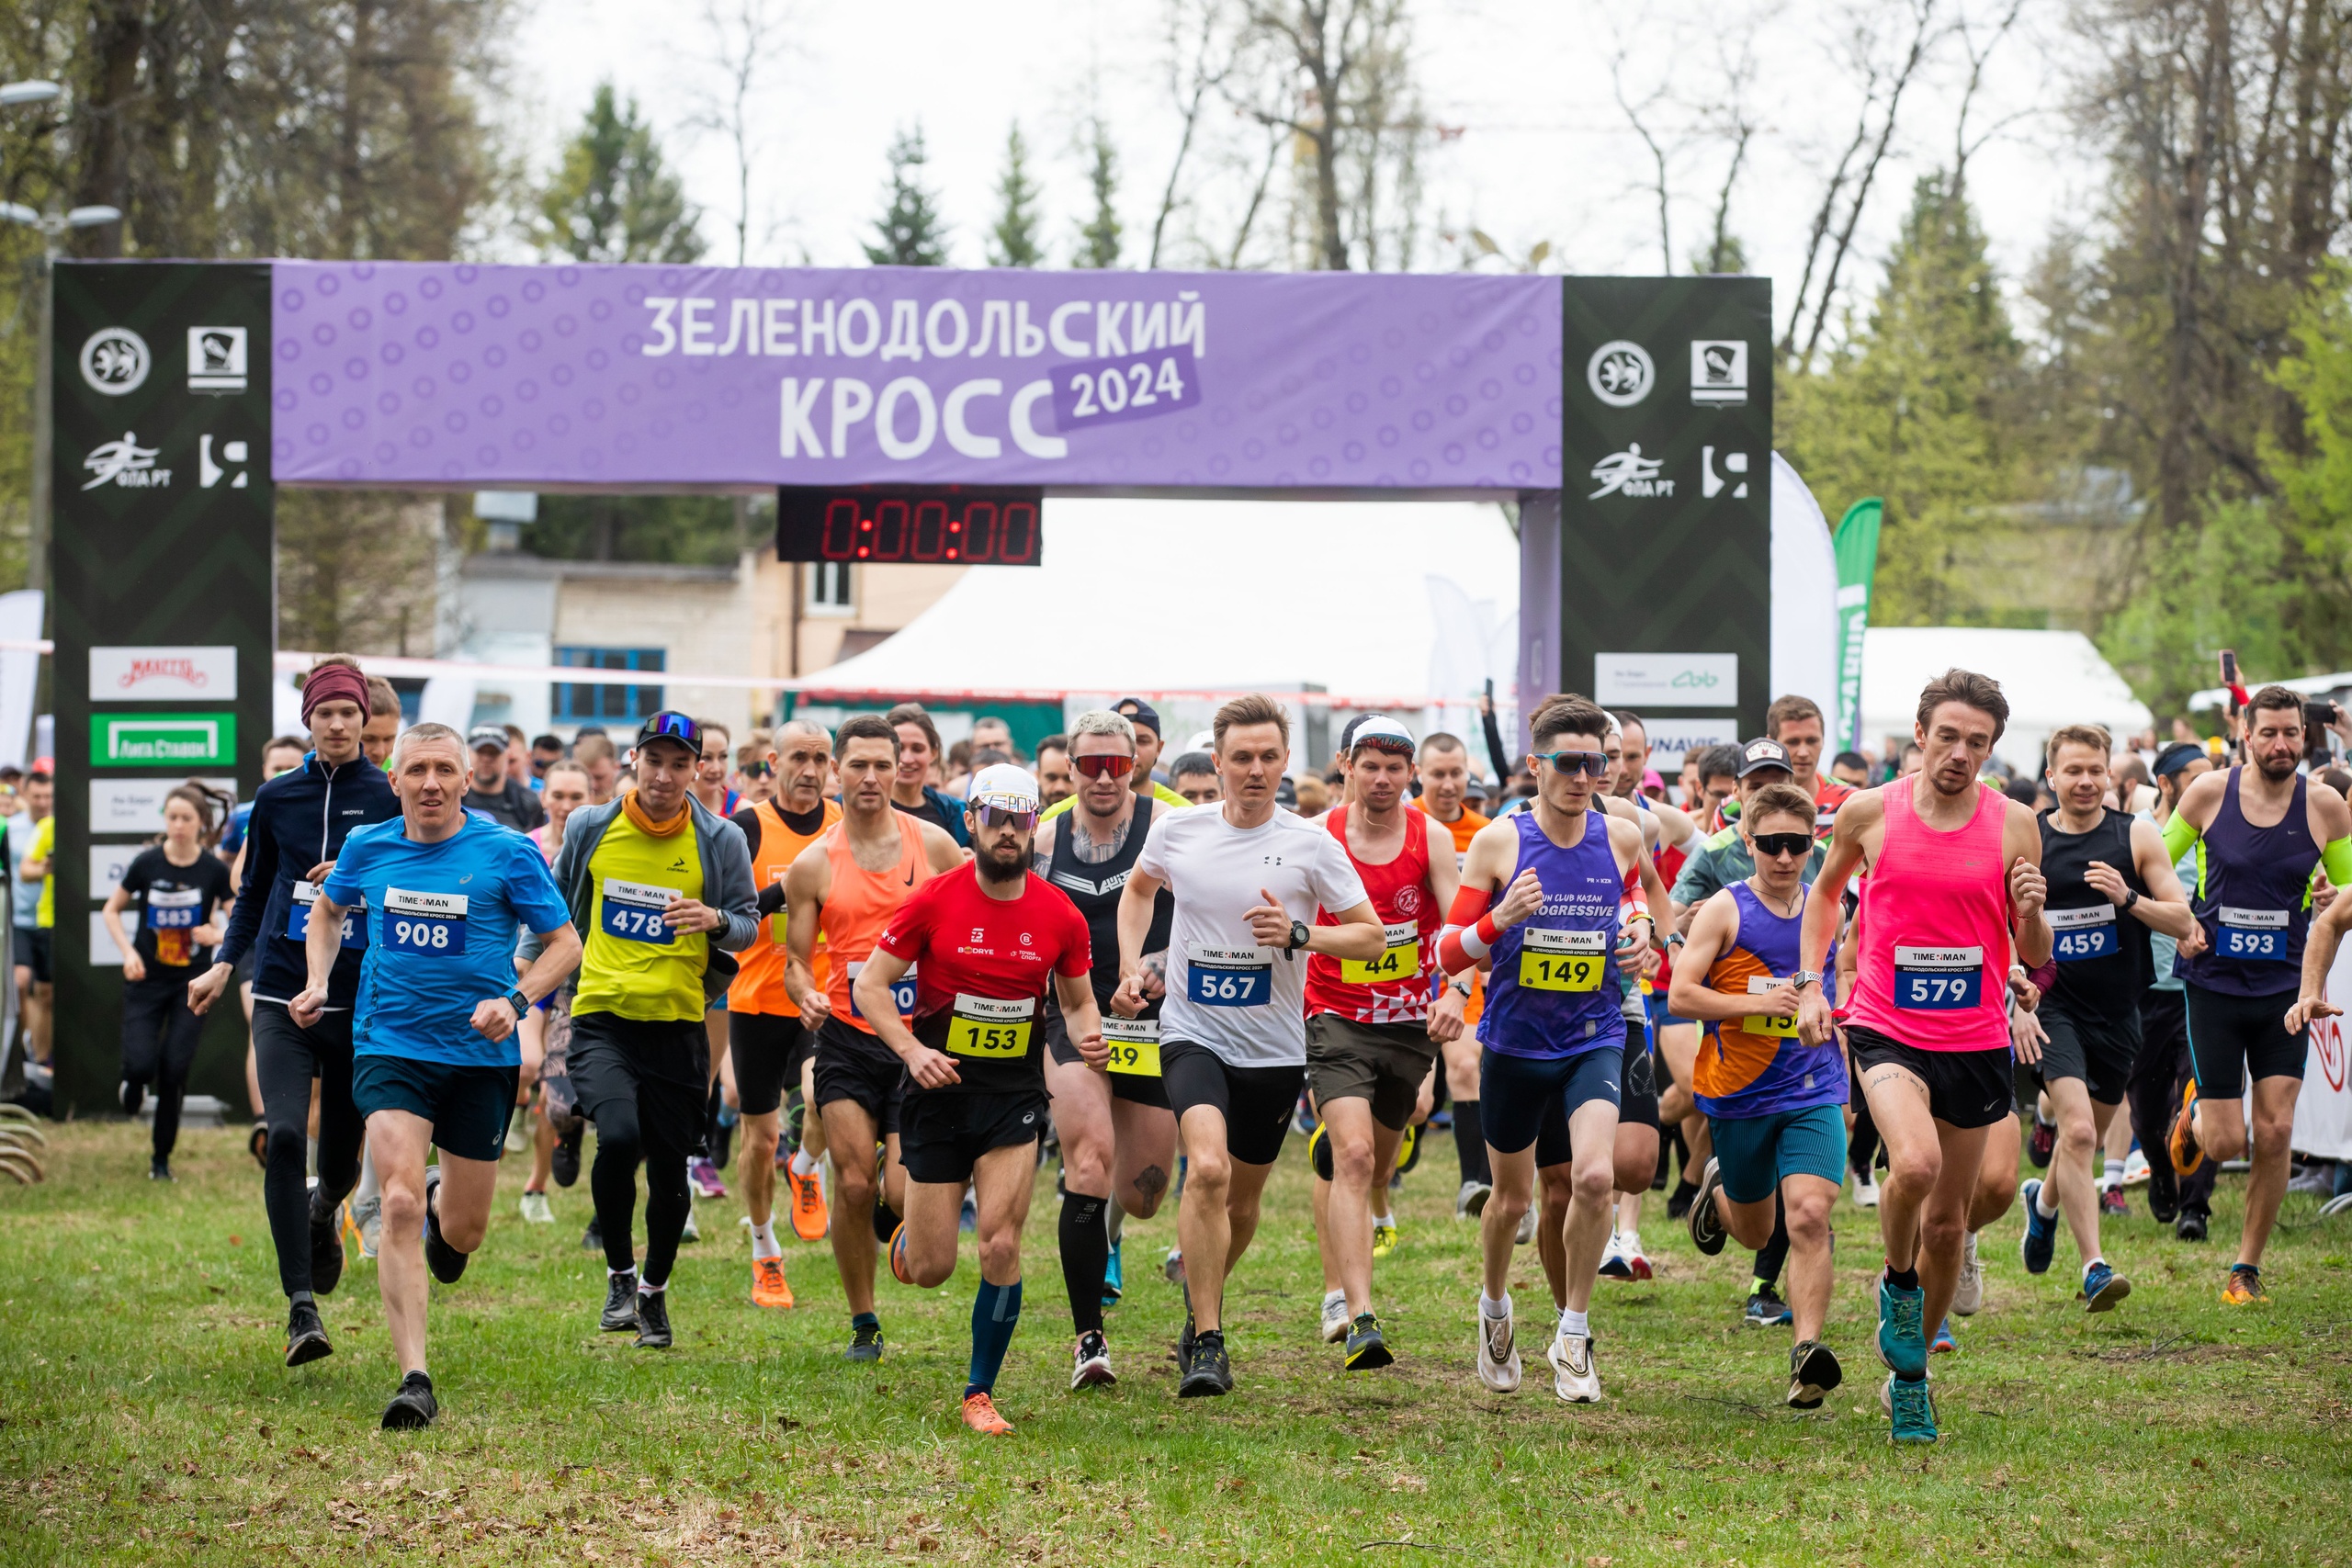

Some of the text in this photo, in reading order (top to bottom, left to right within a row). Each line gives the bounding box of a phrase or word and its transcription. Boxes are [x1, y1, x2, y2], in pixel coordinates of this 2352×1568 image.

[642, 290, 1205, 362] ЗЕЛЕНОДОЛЬСКИЙ
[779, 356, 1185, 459] КРОСС 2024
[820, 499, 1037, 563] 0:00:00
[1555, 894, 1574, 902] CLUB
[1577, 894, 1602, 903] KAZAN
[1529, 905, 1614, 917] ROGRESSIVE
[301, 913, 354, 940] 24
[395, 920, 448, 948] 908
[612, 910, 662, 937] 478
[2058, 931, 2105, 954] 459
[2229, 932, 2274, 953] 593
[1538, 960, 1590, 983] 149
[1201, 975, 1256, 999] 567
[1910, 978, 1967, 1002] 579
[1766, 1016, 1799, 1030] 15
[967, 1027, 1017, 1050] 153
